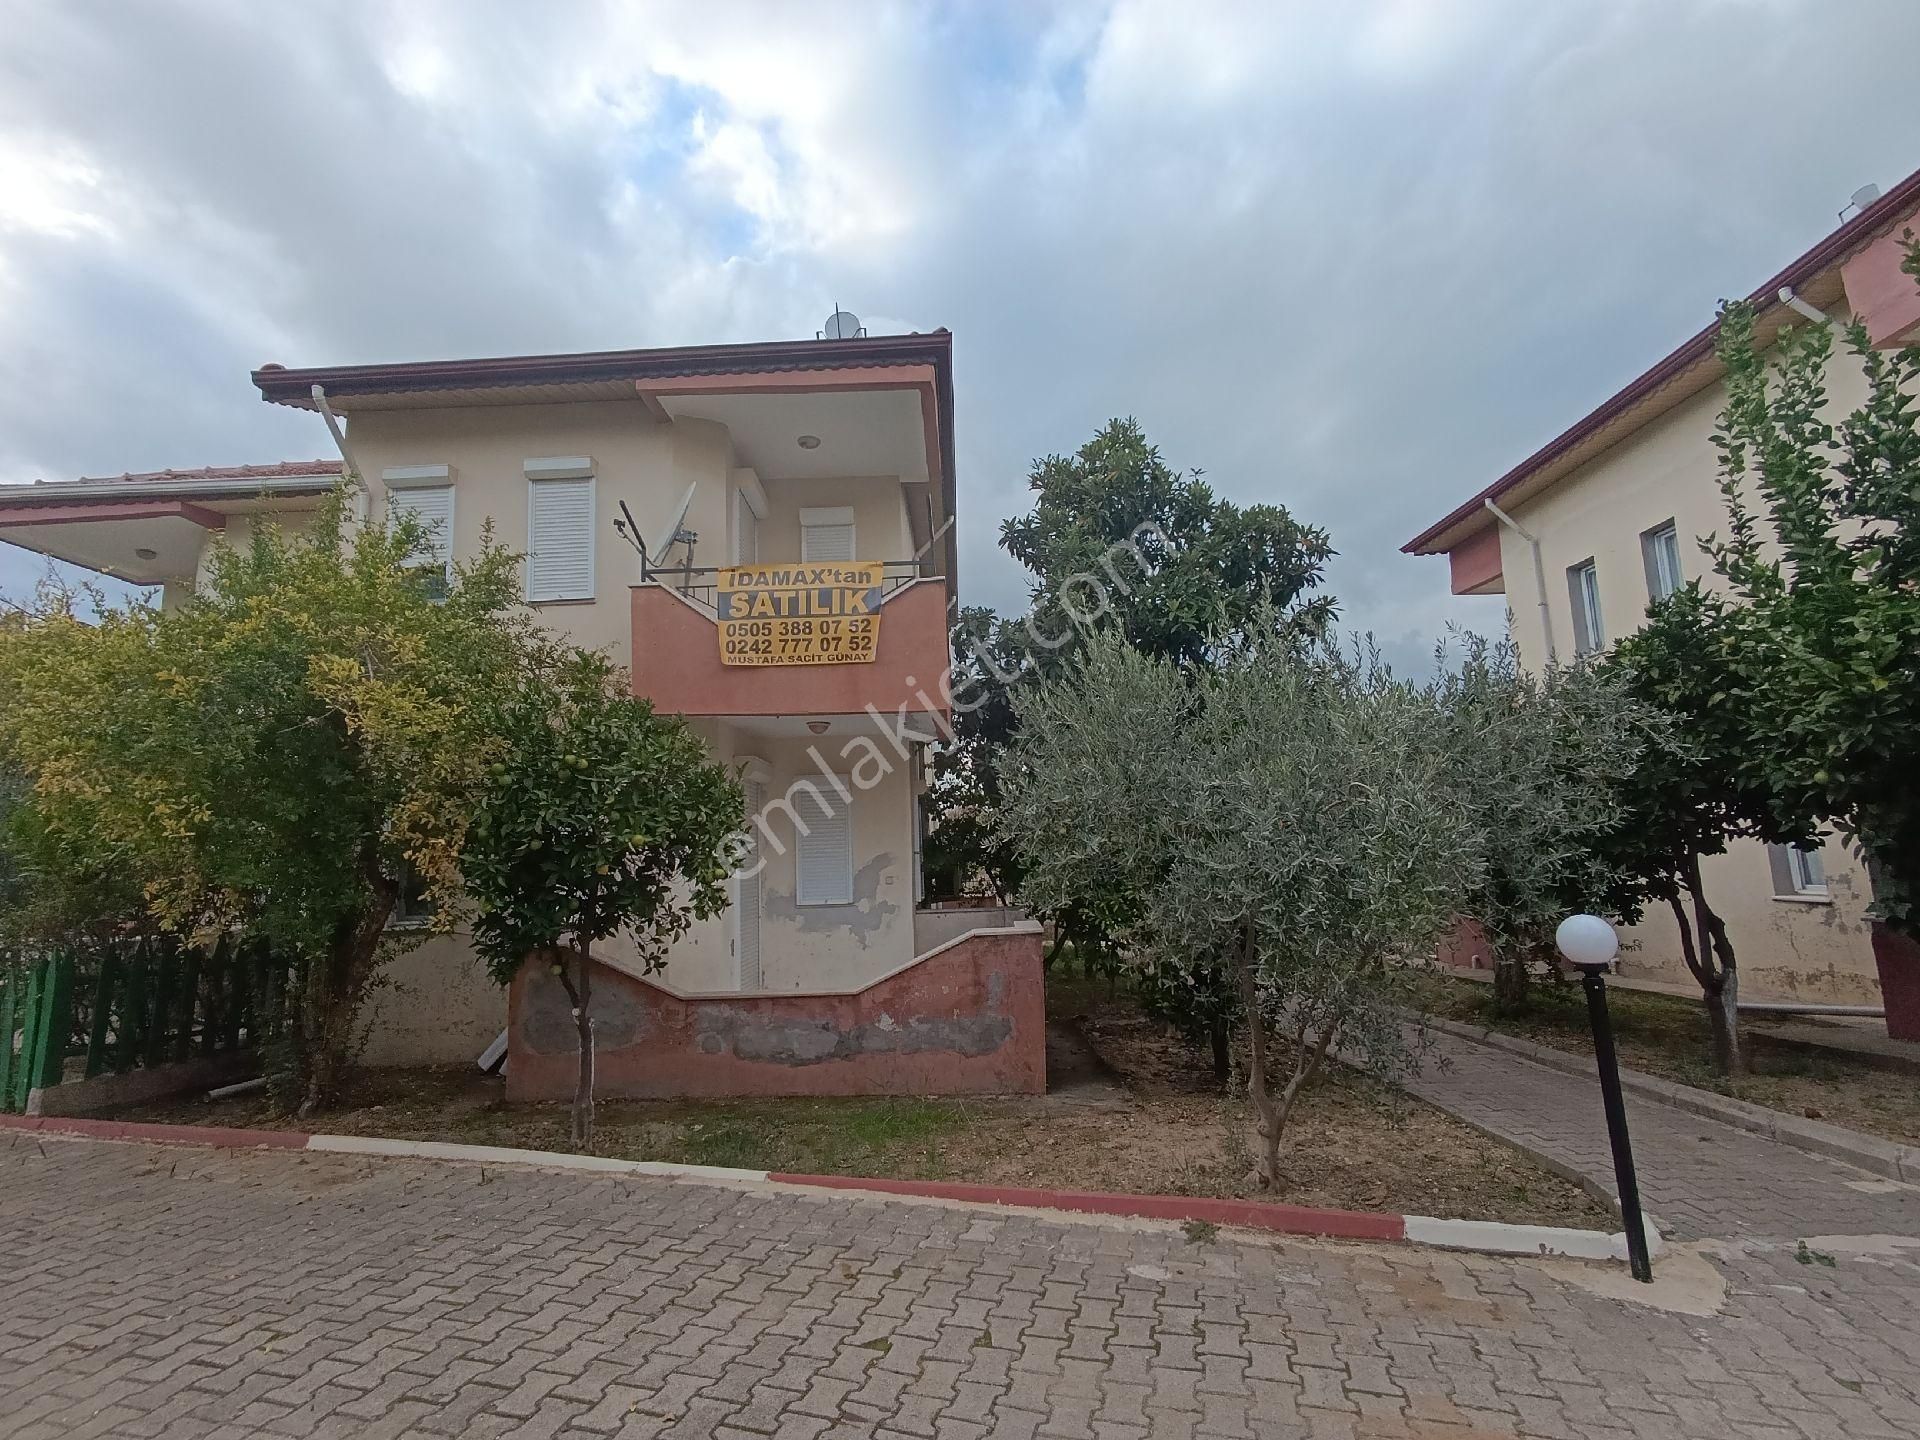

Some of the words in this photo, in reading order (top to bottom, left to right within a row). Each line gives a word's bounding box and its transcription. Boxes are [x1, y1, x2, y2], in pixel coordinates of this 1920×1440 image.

[729, 589, 869, 618] SATILIK
[726, 623, 772, 637] 0505
[779, 621, 813, 636] 388
[820, 620, 842, 634] 07
[848, 619, 872, 633] 52
[726, 639, 772, 654] 0242
[779, 638, 813, 653] 777
[820, 637, 843, 652] 07
[848, 636, 872, 651] 52
[727, 655, 785, 664] MUSTAFA
[827, 653, 869, 662] GÜNAY
